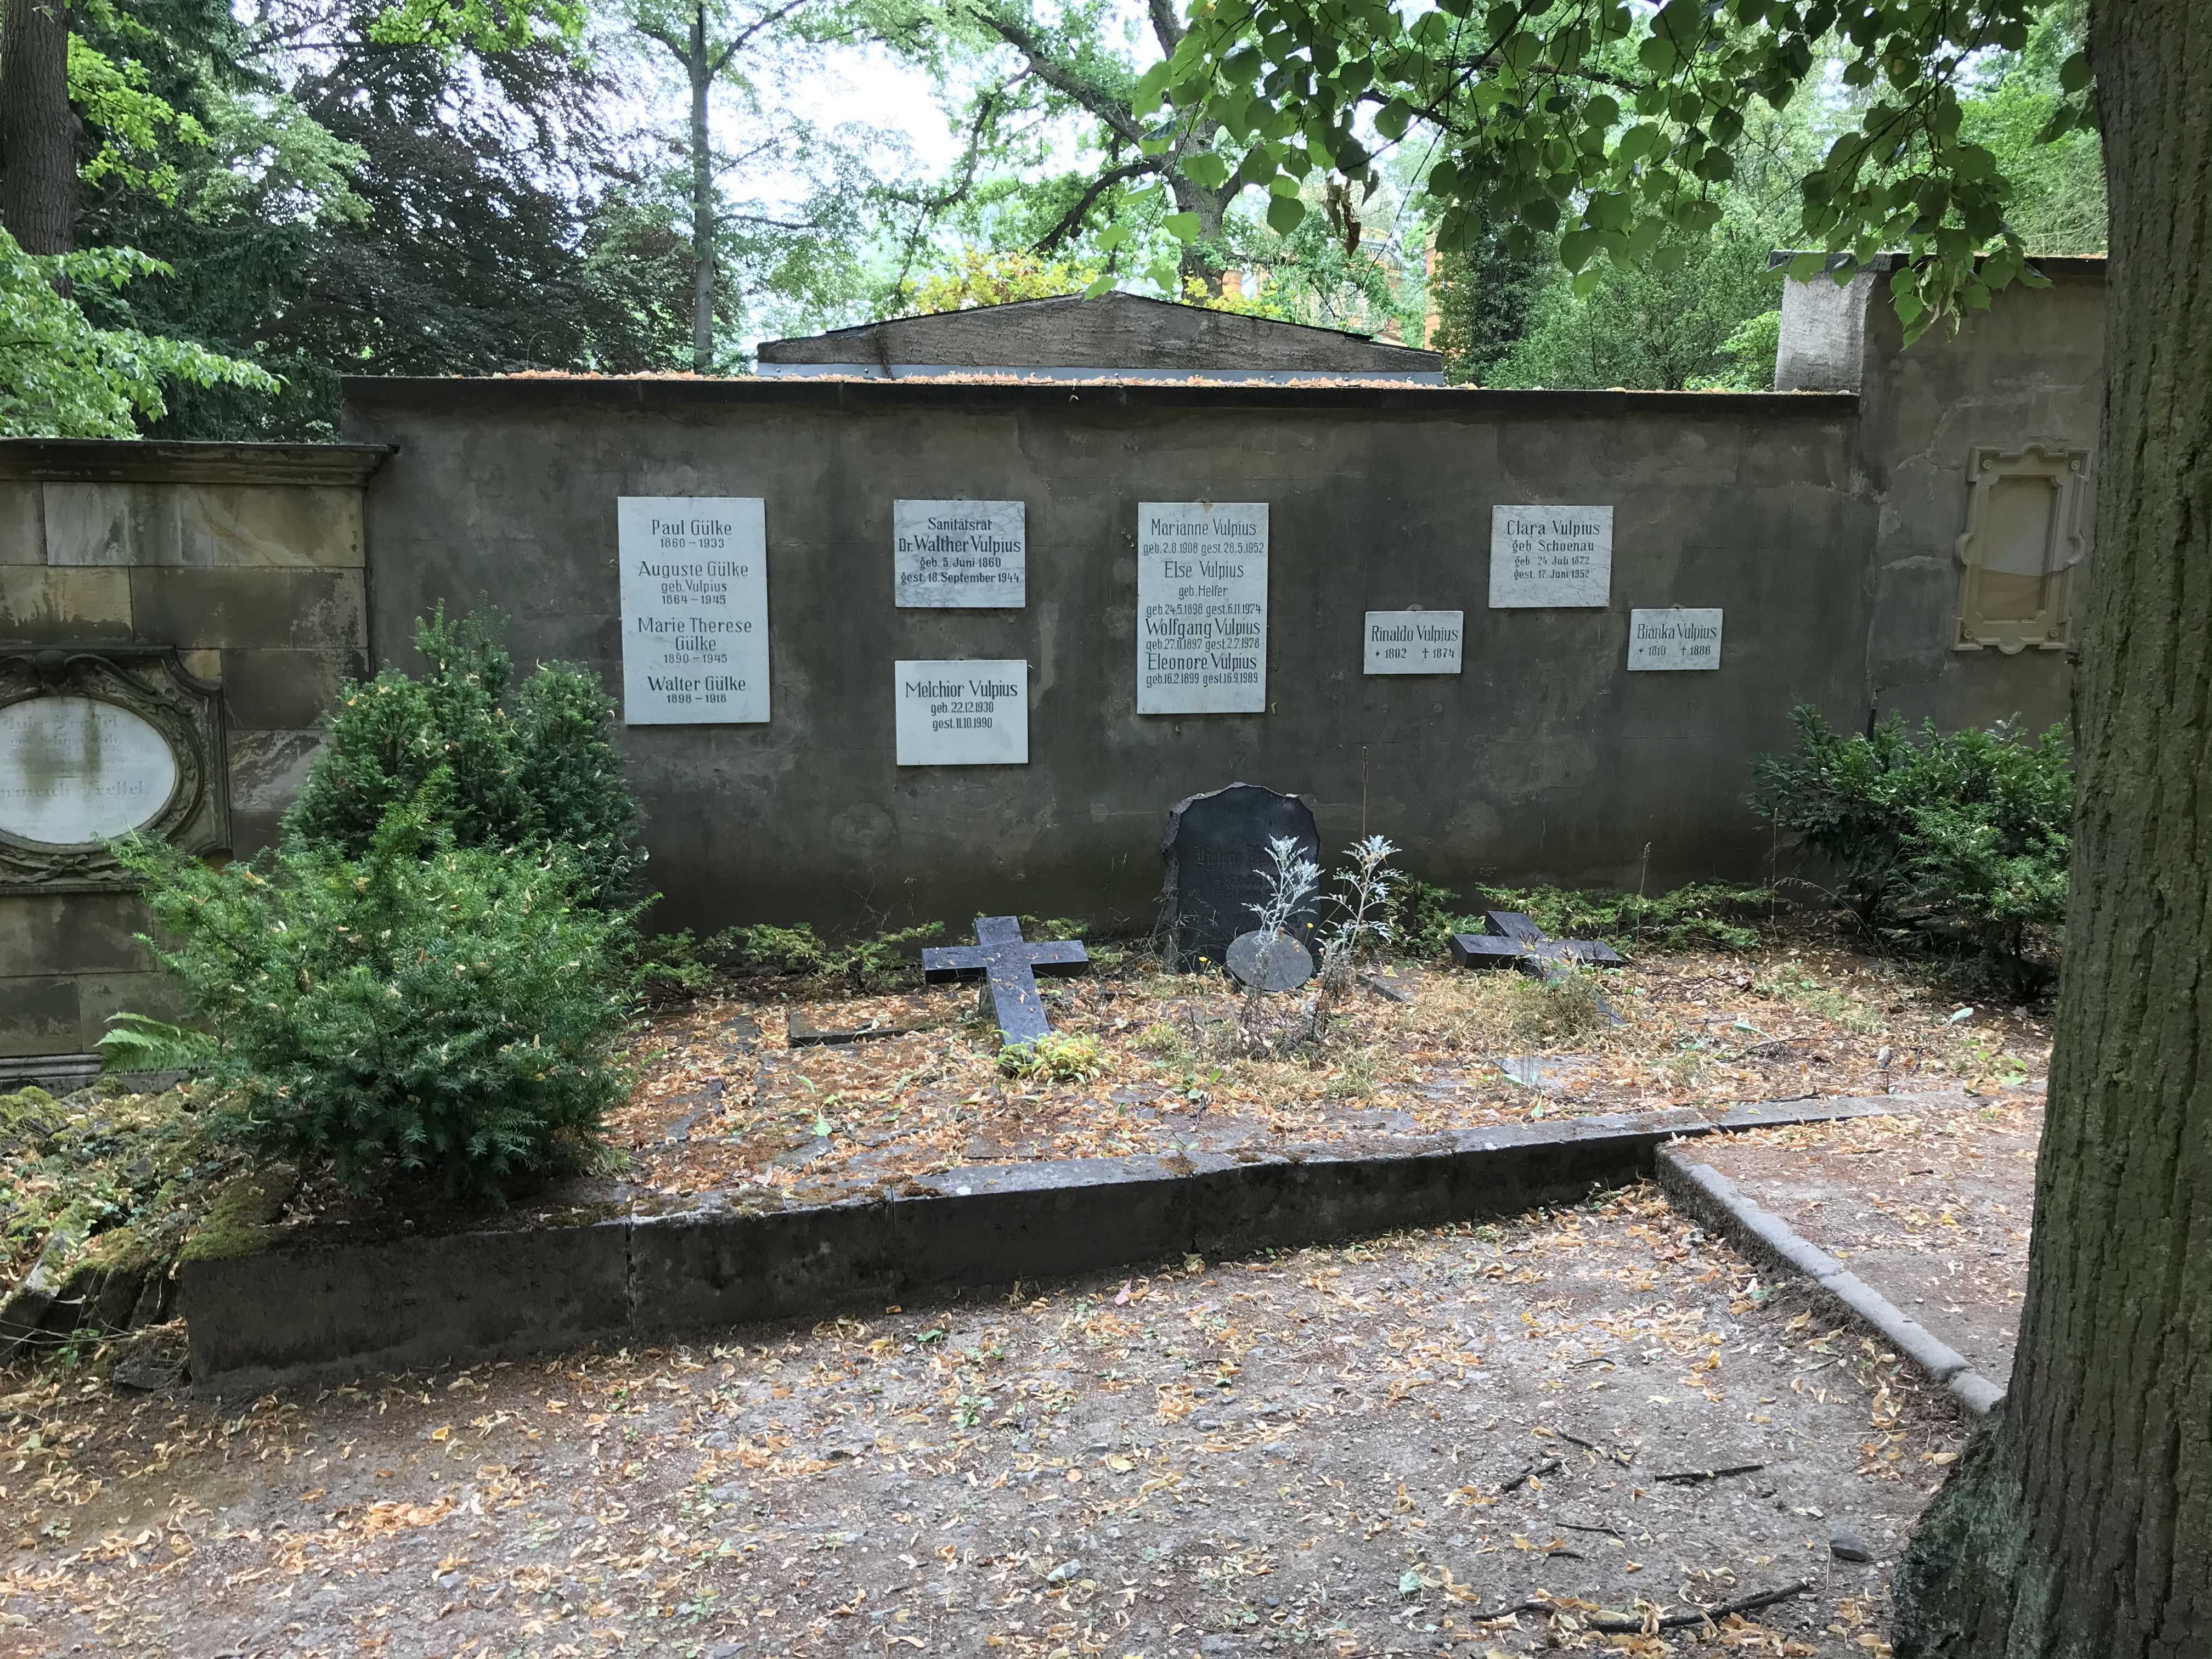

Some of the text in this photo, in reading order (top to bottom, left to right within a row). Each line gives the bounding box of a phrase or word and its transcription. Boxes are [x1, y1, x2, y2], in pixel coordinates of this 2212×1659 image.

[652, 519, 732, 536] Paul Gülke
[928, 517, 992, 531] Sanitätsrat
[1151, 518, 1256, 538] Marianne Vulpius
[1507, 520, 1601, 538] Clara Vulpius
[660, 538, 685, 549] 1860
[699, 538, 725, 549] 1933
[913, 535, 969, 553] Walther
[970, 535, 1022, 556] Vulpius
[1538, 539, 1594, 552] Schoenau
[952, 557, 975, 568] Juni
[978, 557, 1001, 568] 1860
[1551, 556, 1569, 566] Juli
[1572, 556, 1590, 565] 1872
[638, 561, 749, 579] Auguste Gülke
[1165, 560, 1244, 580] Else Vulpius
[1549, 569, 1568, 579] Juni
[1571, 569, 1590, 579] 1952
[940, 572, 996, 584] September
[997, 572, 1019, 583] 1944
[685, 579, 727, 594] Vulpius
[1198, 585, 1228, 597] Helfer
[662, 595, 688, 605] 1864
[701, 595, 726, 605] 1945
[637, 617, 752, 633] Marie Therese
[1145, 617, 1261, 640] Wolfgang Vulpius
[1637, 623, 1717, 641] Bianka Vulpius
[1372, 625, 1459, 644] Rinaldo Vulpius
[675, 636, 717, 652] Gülke
[1648, 645, 1711, 656] 1810 1886
[664, 654, 690, 663] 1890
[702, 654, 728, 663] 1945
[1385, 647, 1454, 659] 1802 1874
[1148, 652, 1257, 672] Eleonore Vulpius
[647, 675, 746, 691] Walter Gülke
[906, 680, 1018, 700] Melchior Vulpius
[666, 693, 692, 703] 1898
[705, 694, 727, 703] 1918
